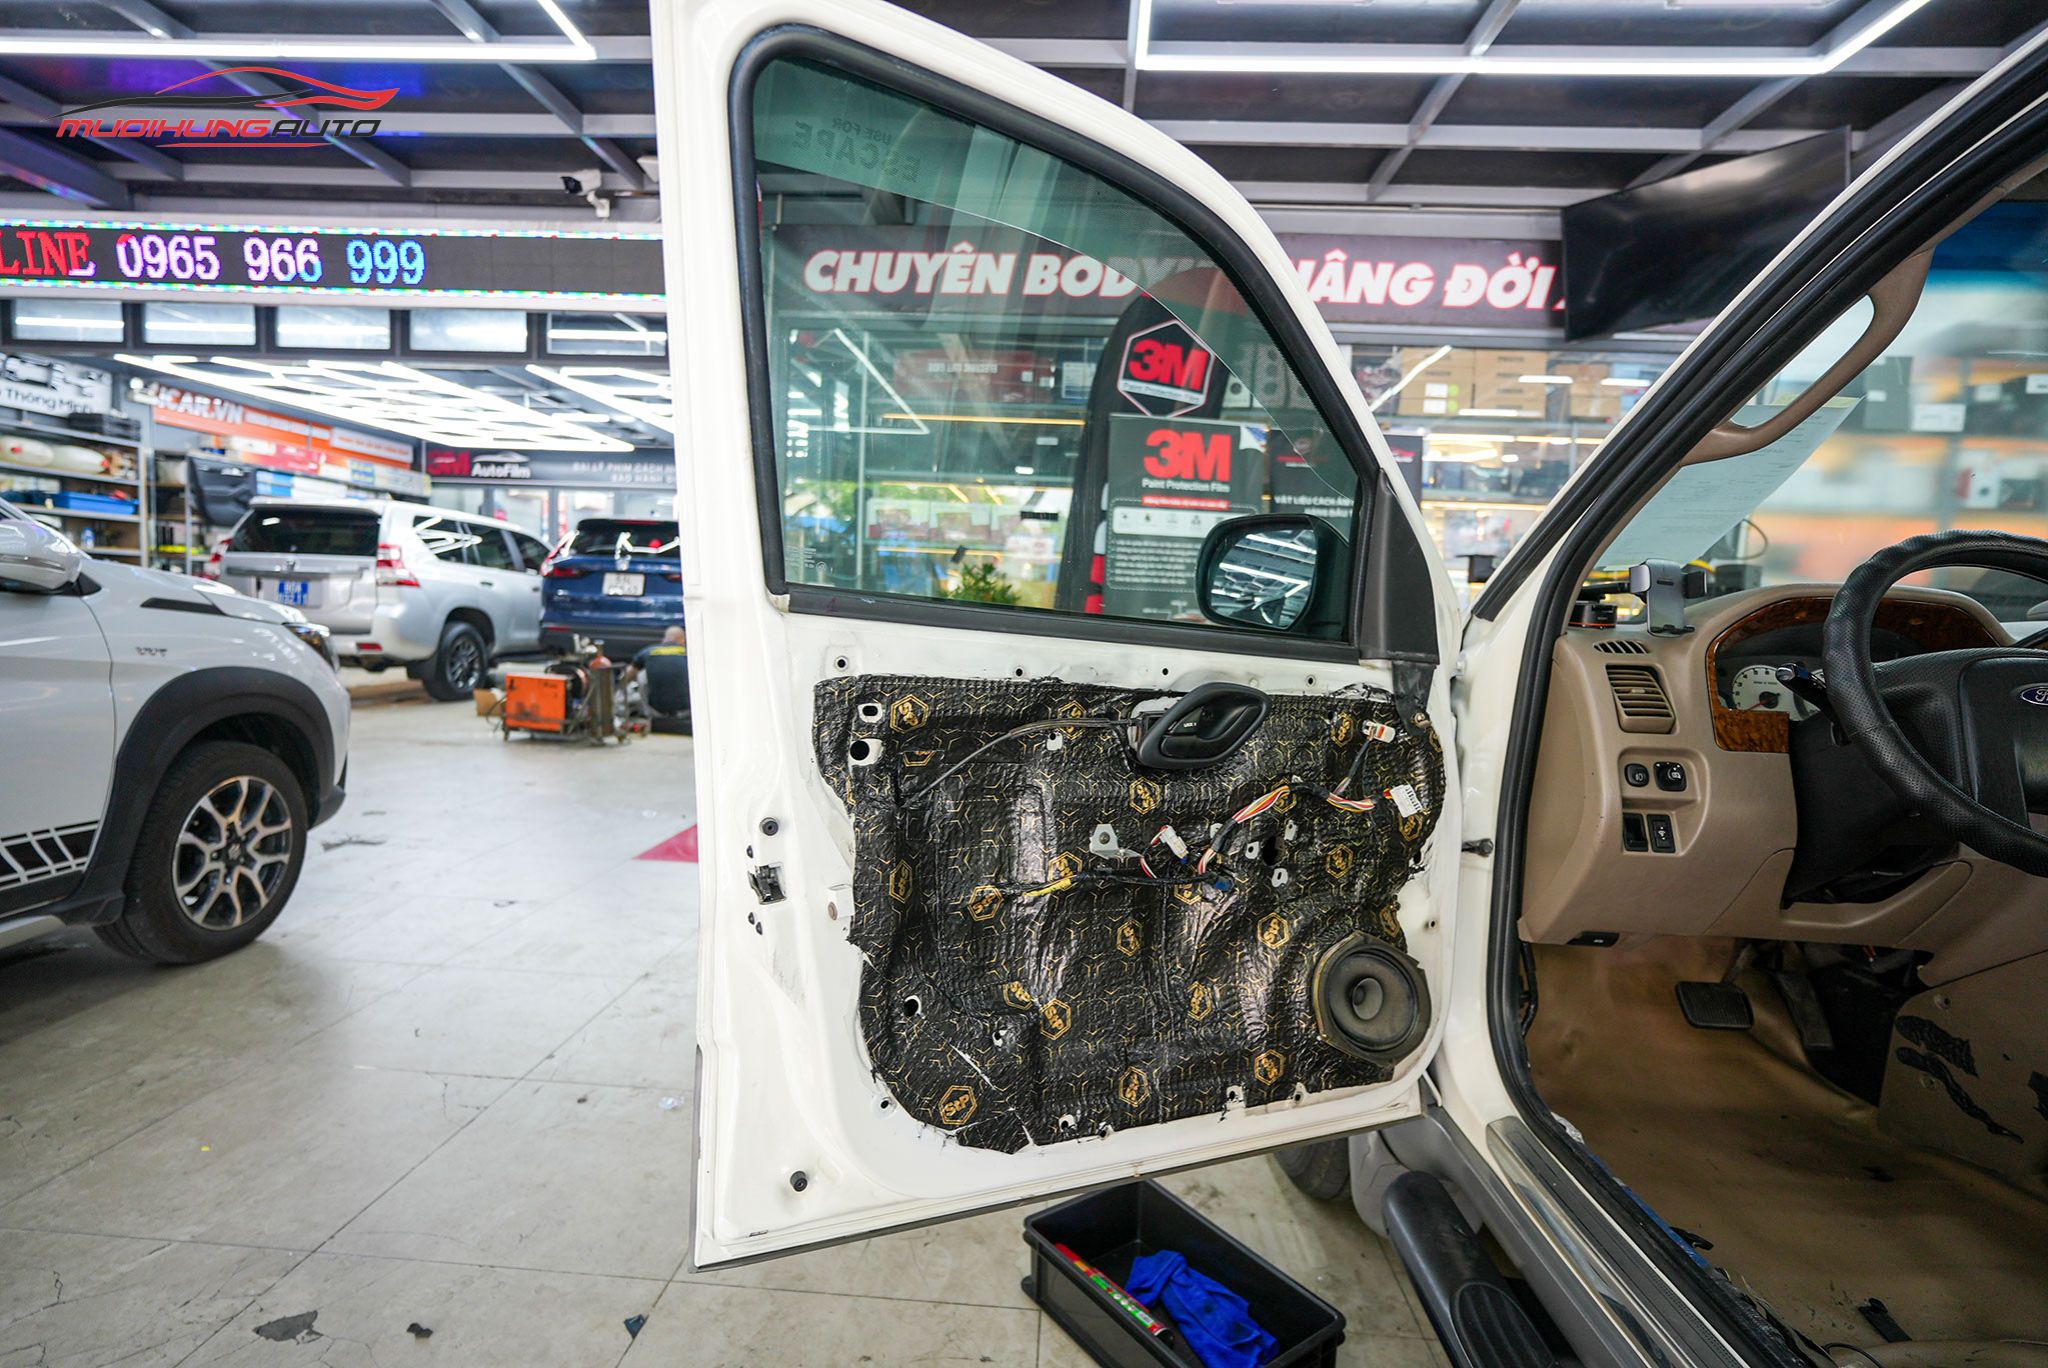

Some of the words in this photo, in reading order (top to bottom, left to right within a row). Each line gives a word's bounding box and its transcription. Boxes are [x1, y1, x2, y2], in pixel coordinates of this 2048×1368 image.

[116, 234, 220, 281] 0965
[243, 237, 323, 282] 966
[345, 239, 426, 285] 999
[803, 241, 1017, 295] CHUYÊN
[1442, 251, 1559, 310] ĐỜI
[1128, 338, 1210, 391] 3M
[471, 463, 531, 479] AutoFilm
[1143, 428, 1232, 482] 3M
